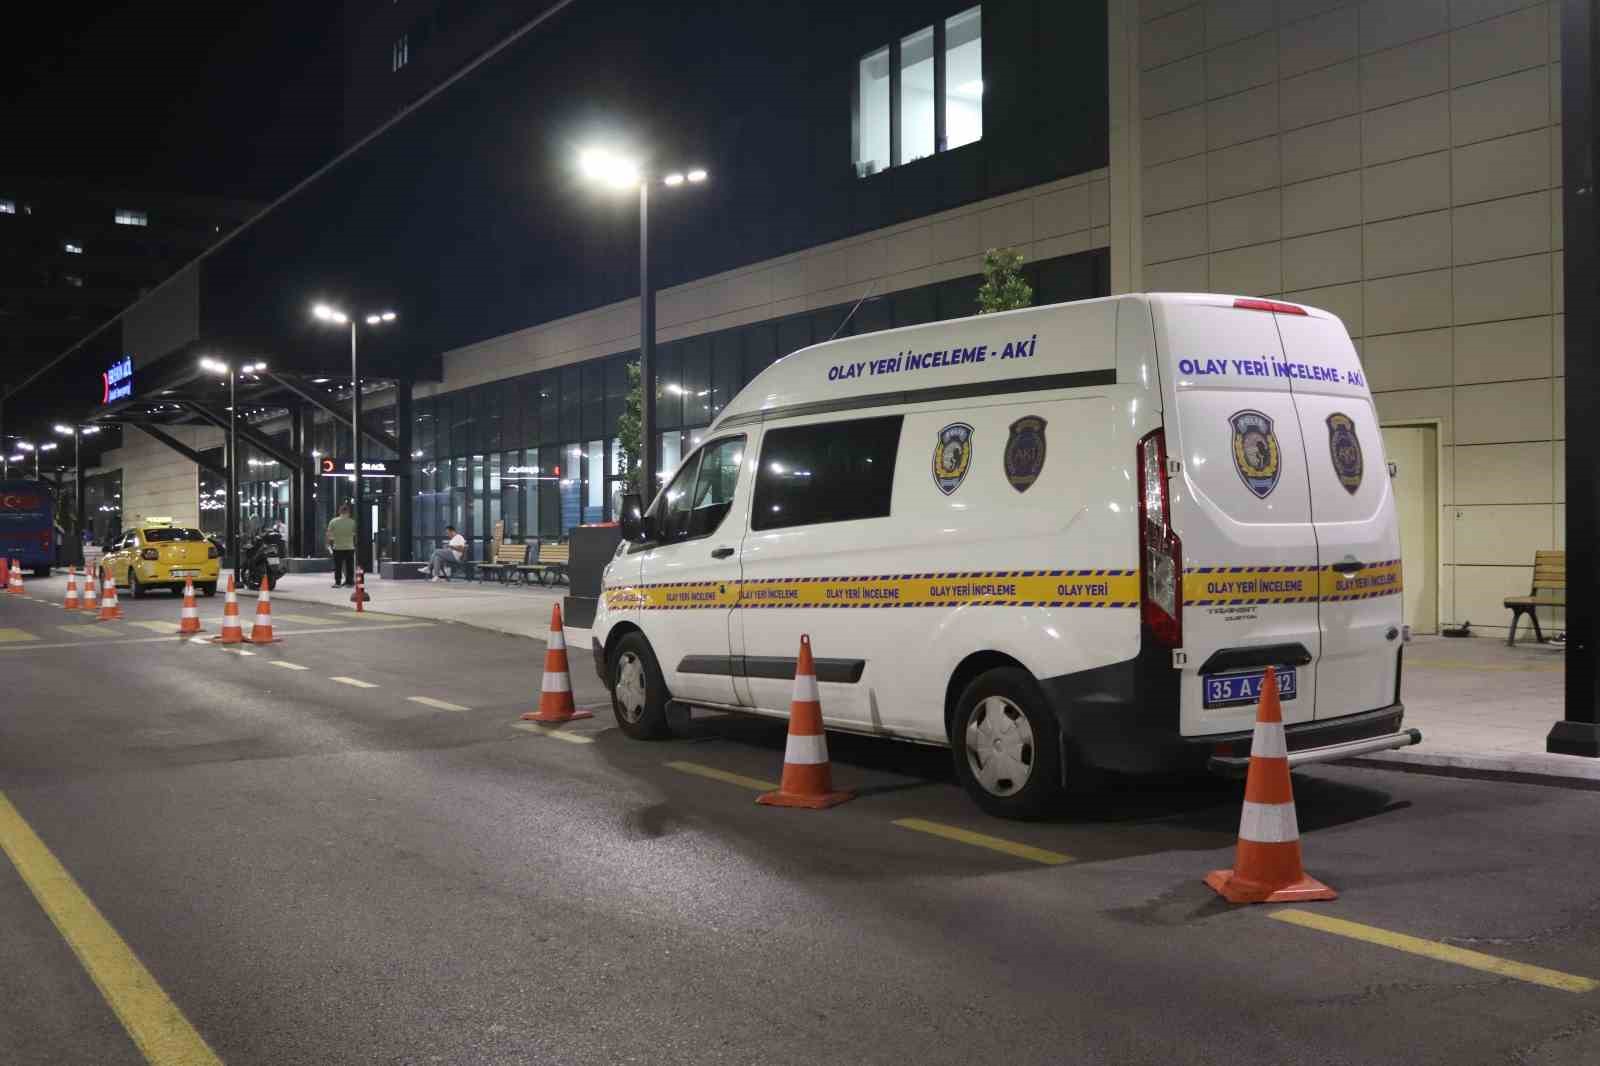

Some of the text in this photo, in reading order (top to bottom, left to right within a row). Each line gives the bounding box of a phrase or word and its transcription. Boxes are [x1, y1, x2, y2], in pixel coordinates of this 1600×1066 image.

[828, 361, 866, 381] OLAY
[869, 352, 903, 375] YERİ
[905, 345, 988, 371] İNCELEME
[1001, 334, 1037, 359] AKİ
[1179, 359, 1227, 375] OLAY
[1232, 355, 1269, 376] YERİ
[1271, 356, 1340, 382] İNCELEME
[826, 586, 899, 599] OLAY YERİ İNCELEME
[930, 582, 1016, 597] OLAY YERİ İNCELEME
[1058, 581, 1108, 596] OLAY YERİ
[1208, 579, 1303, 593] OLAY YERİ İNCELEME
[1212, 681, 1232, 699] 35
[1240, 679, 1252, 697] A
